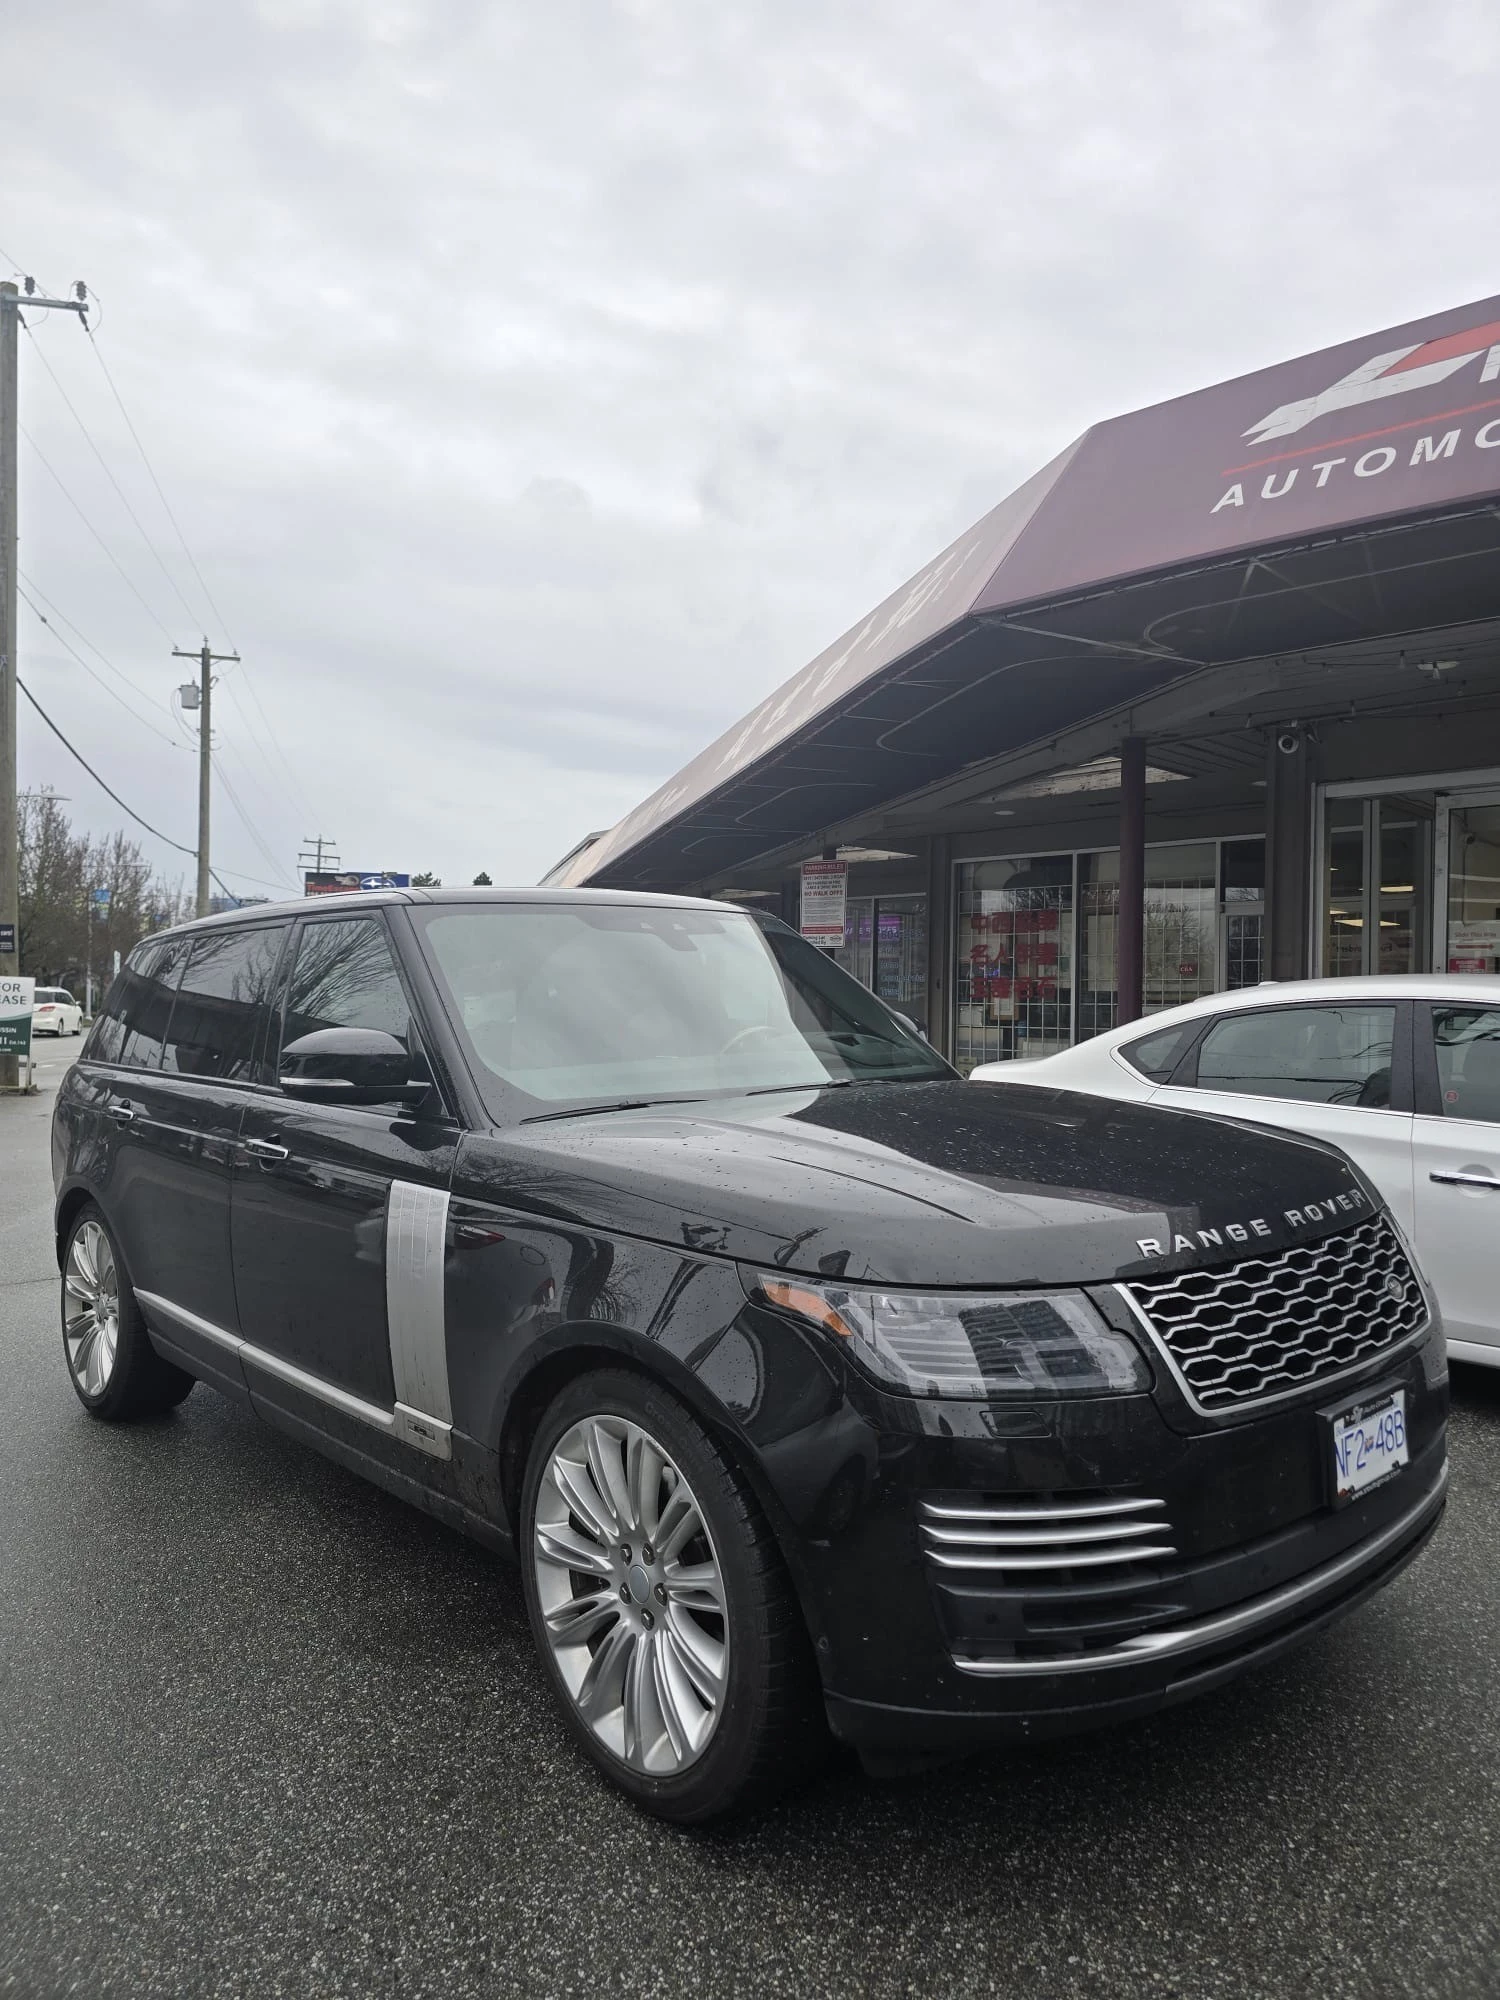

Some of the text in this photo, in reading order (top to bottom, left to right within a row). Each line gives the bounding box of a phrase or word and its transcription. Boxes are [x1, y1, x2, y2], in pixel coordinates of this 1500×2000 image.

[0, 982, 21, 993] OR
[1135, 1188, 1367, 1259] RANGE ROVER
